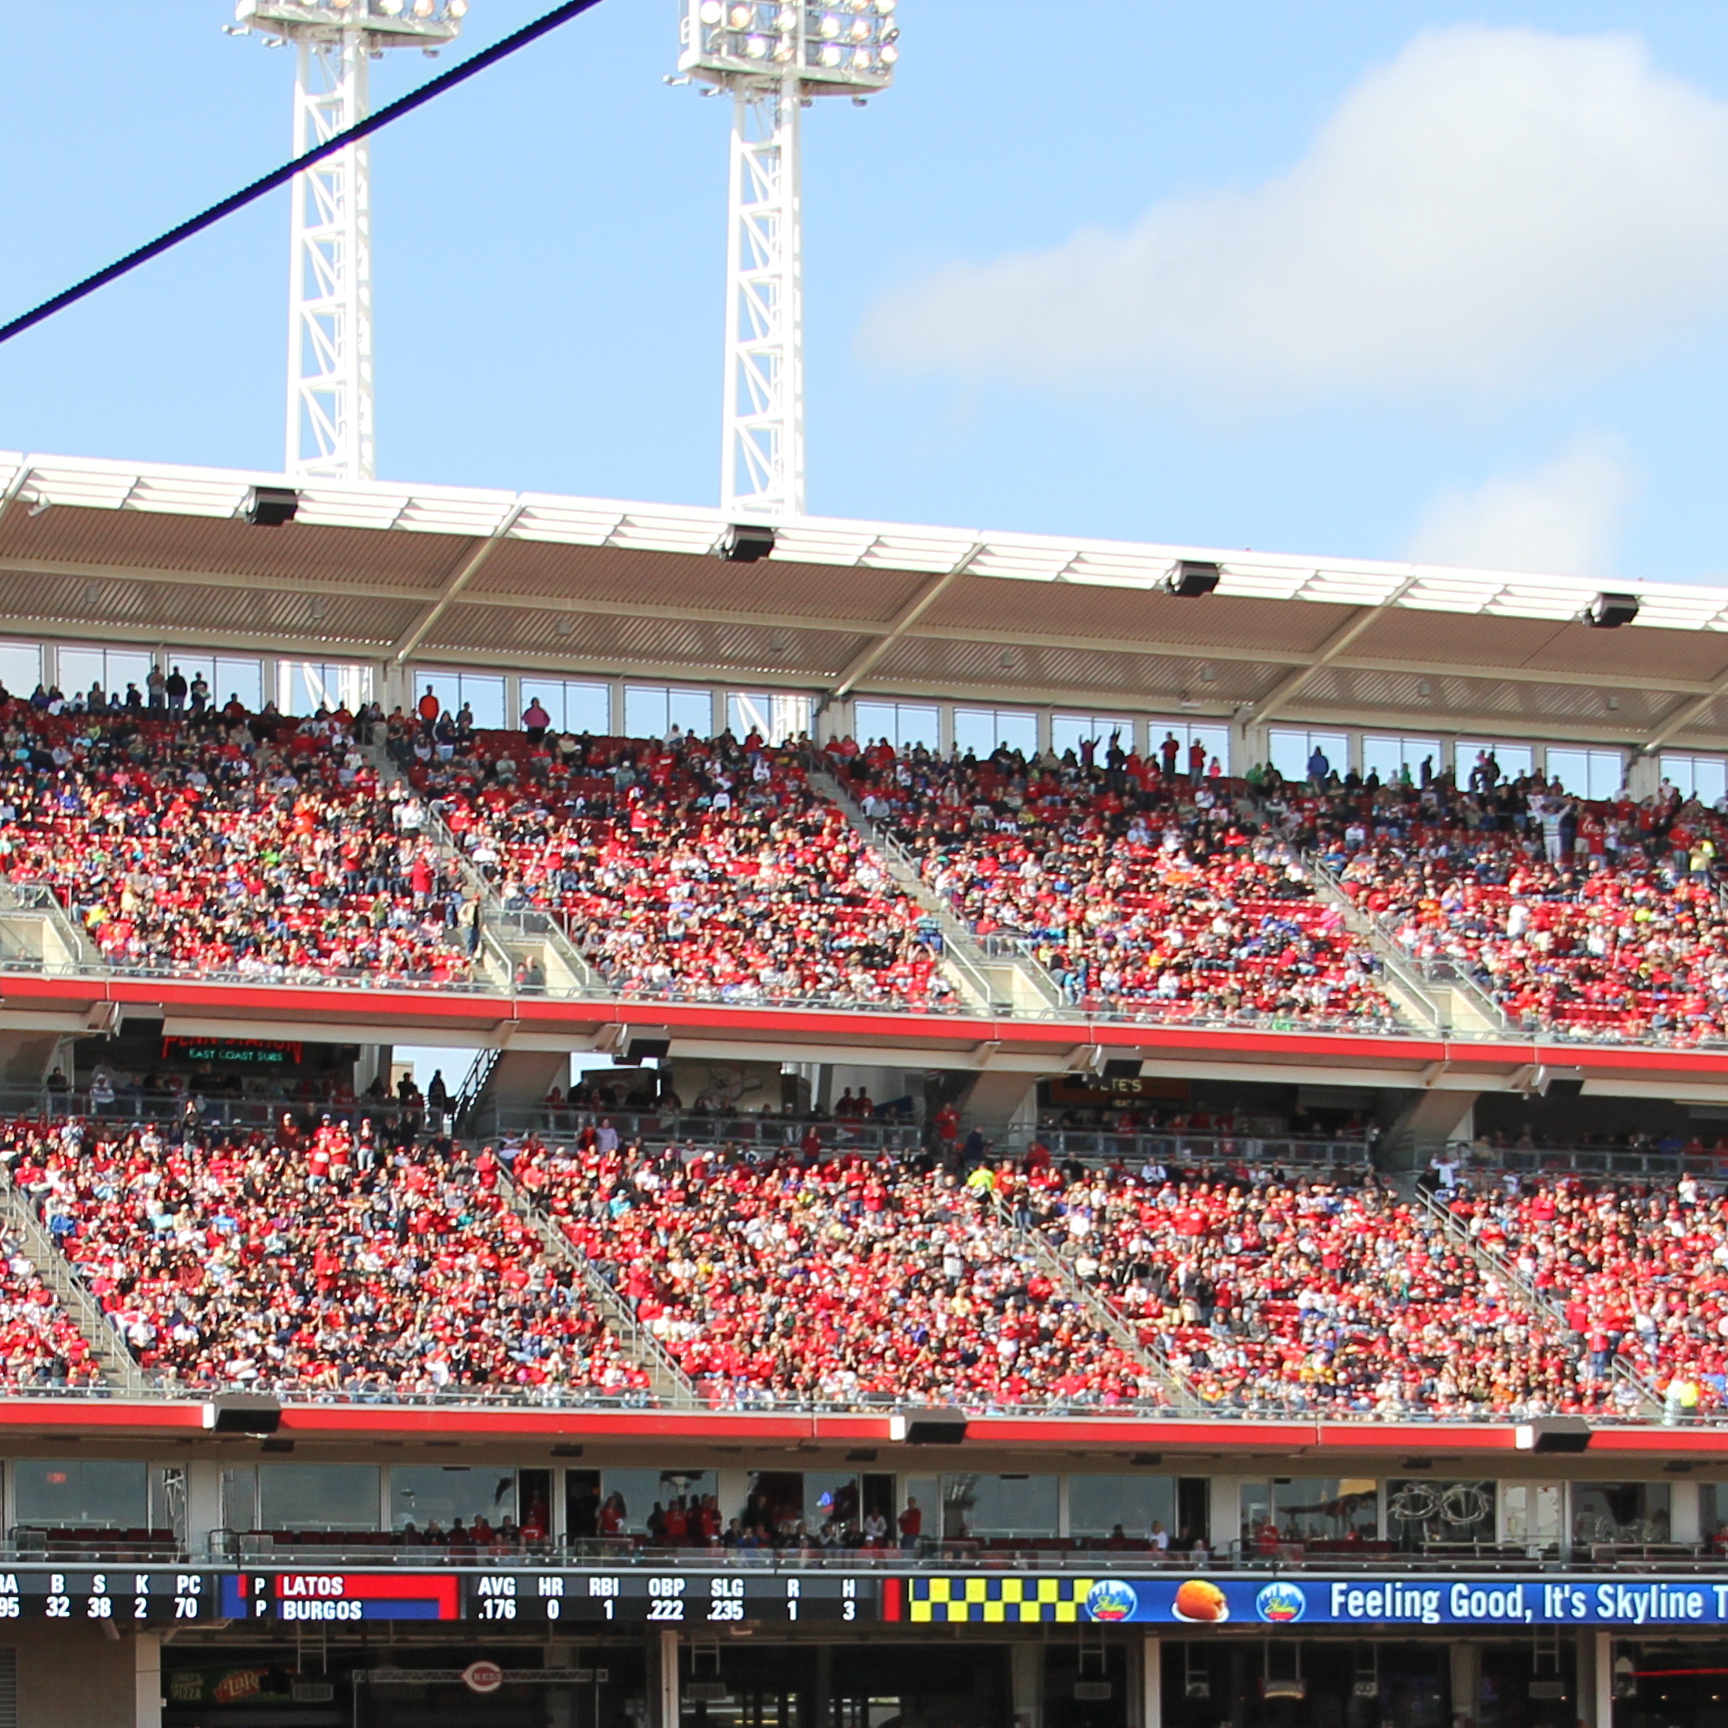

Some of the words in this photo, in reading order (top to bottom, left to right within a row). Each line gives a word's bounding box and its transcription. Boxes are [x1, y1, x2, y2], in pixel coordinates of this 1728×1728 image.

[189, 1049, 215, 1059] EAST
[219, 1051, 254, 1060] COAST
[257, 1052, 283, 1062] SUBS
[51, 1575, 65, 1594] B
[92, 1575, 106, 1594] S
[135, 1575, 149, 1594] K
[176, 1575, 201, 1595] PC
[254, 1578, 265, 1595] P
[283, 1577, 343, 1596] LATOS
[477, 1577, 516, 1596] AVG
[538, 1577, 564, 1597] HR
[589, 1578, 619, 1597] RBI
[648, 1578, 685, 1597] OBP
[710, 1578, 744, 1598] SLG
[787, 1579, 800, 1598] R
[842, 1579, 855, 1598] H
[45, 1597, 70, 1617] 32
[87, 1597, 111, 1618] 38
[134, 1598, 147, 1618] 2
[174, 1598, 198, 1618] 70
[255, 1600, 267, 1617] P
[283, 1601, 362, 1620] BURGOS
[478, 1599, 516, 1620] .176
[547, 1600, 559, 1620] 0
[603, 1600, 613, 1620] 1
[646, 1600, 684, 1620] .222
[706, 1600, 744, 1621] .235
[787, 1601, 797, 1621] 1
[842, 1601, 855, 1621] 3
[1330, 1581, 1441, 1624] Feeling
[1450, 1583, 1533, 1624] Good,
[1544, 1584, 1586, 1618] It's
[1597, 1583, 1704, 1624] Skyline
